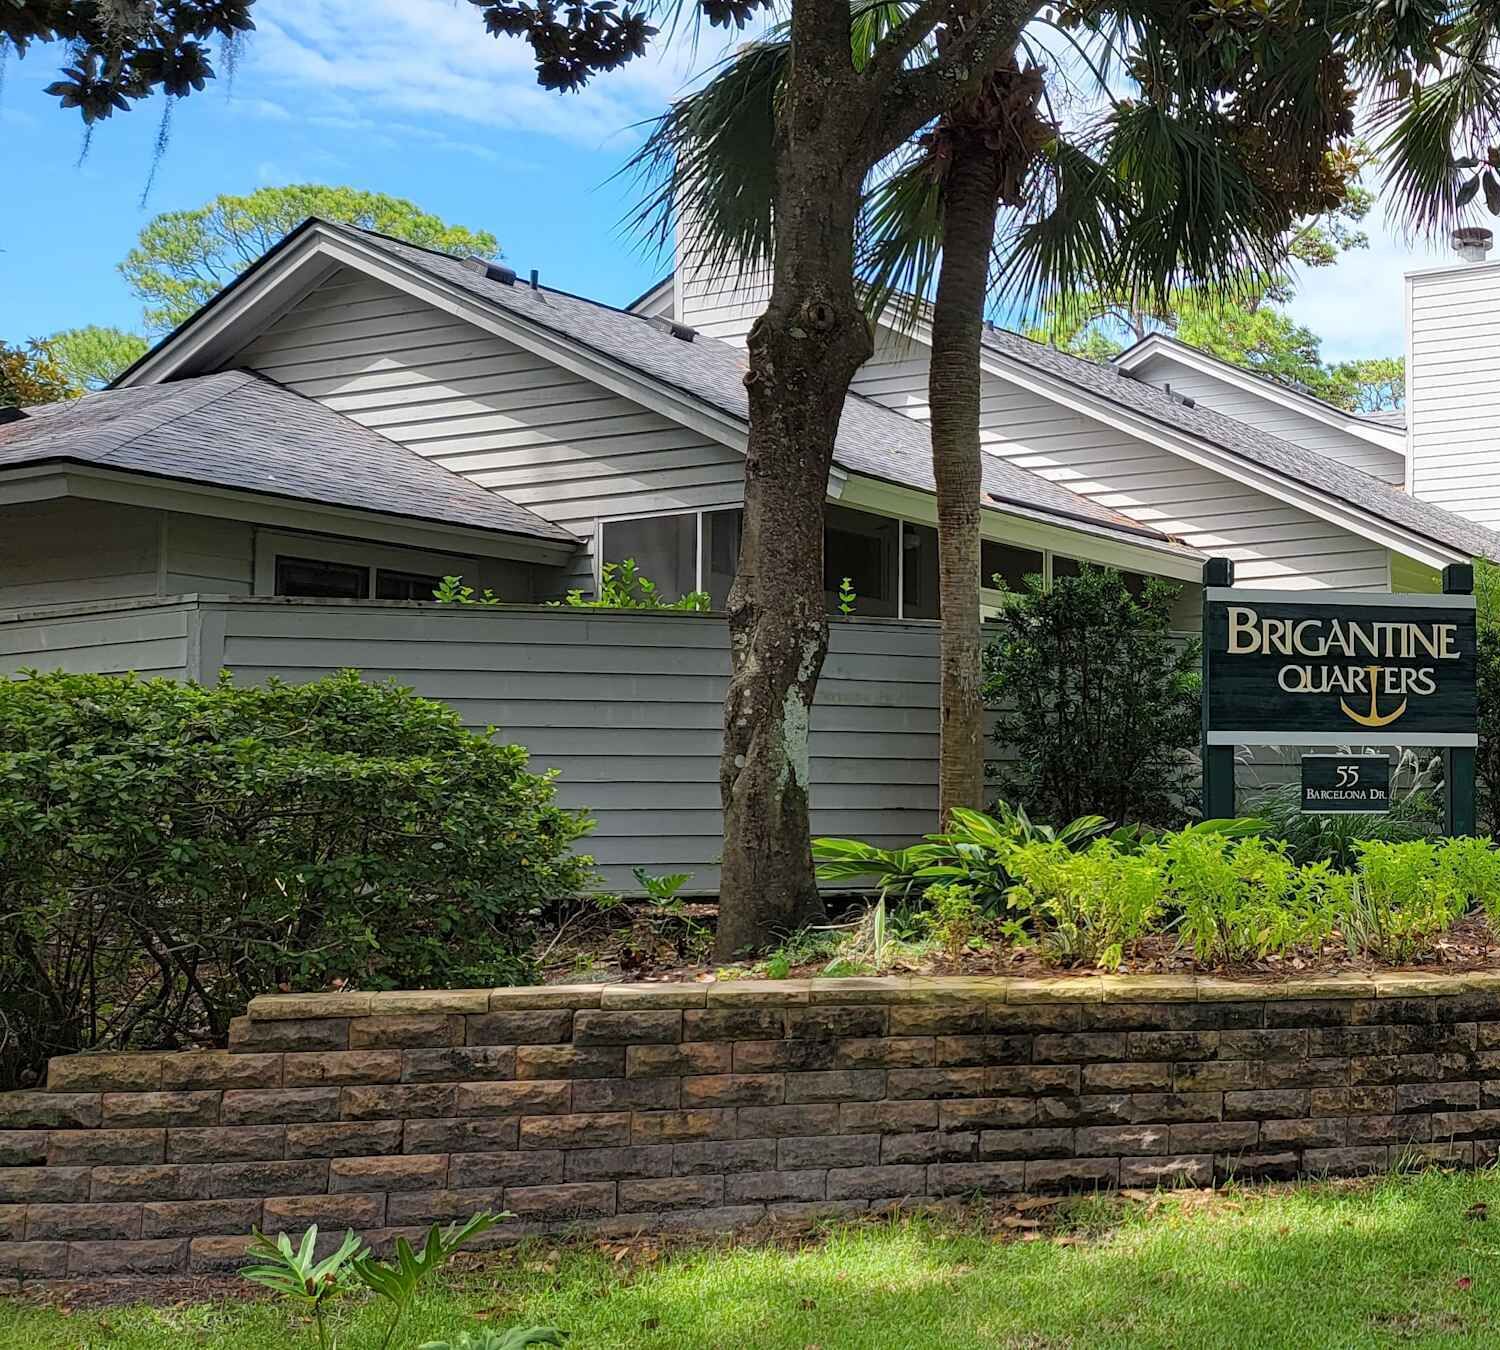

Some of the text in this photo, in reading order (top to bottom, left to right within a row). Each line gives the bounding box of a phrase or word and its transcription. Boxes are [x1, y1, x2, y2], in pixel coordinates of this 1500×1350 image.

[1226, 607, 1461, 659] BRIGANTINE
[1278, 665, 1437, 695] QUARTERS
[1336, 766, 1359, 787] 55
[1306, 788, 1367, 800] BARCELONA
